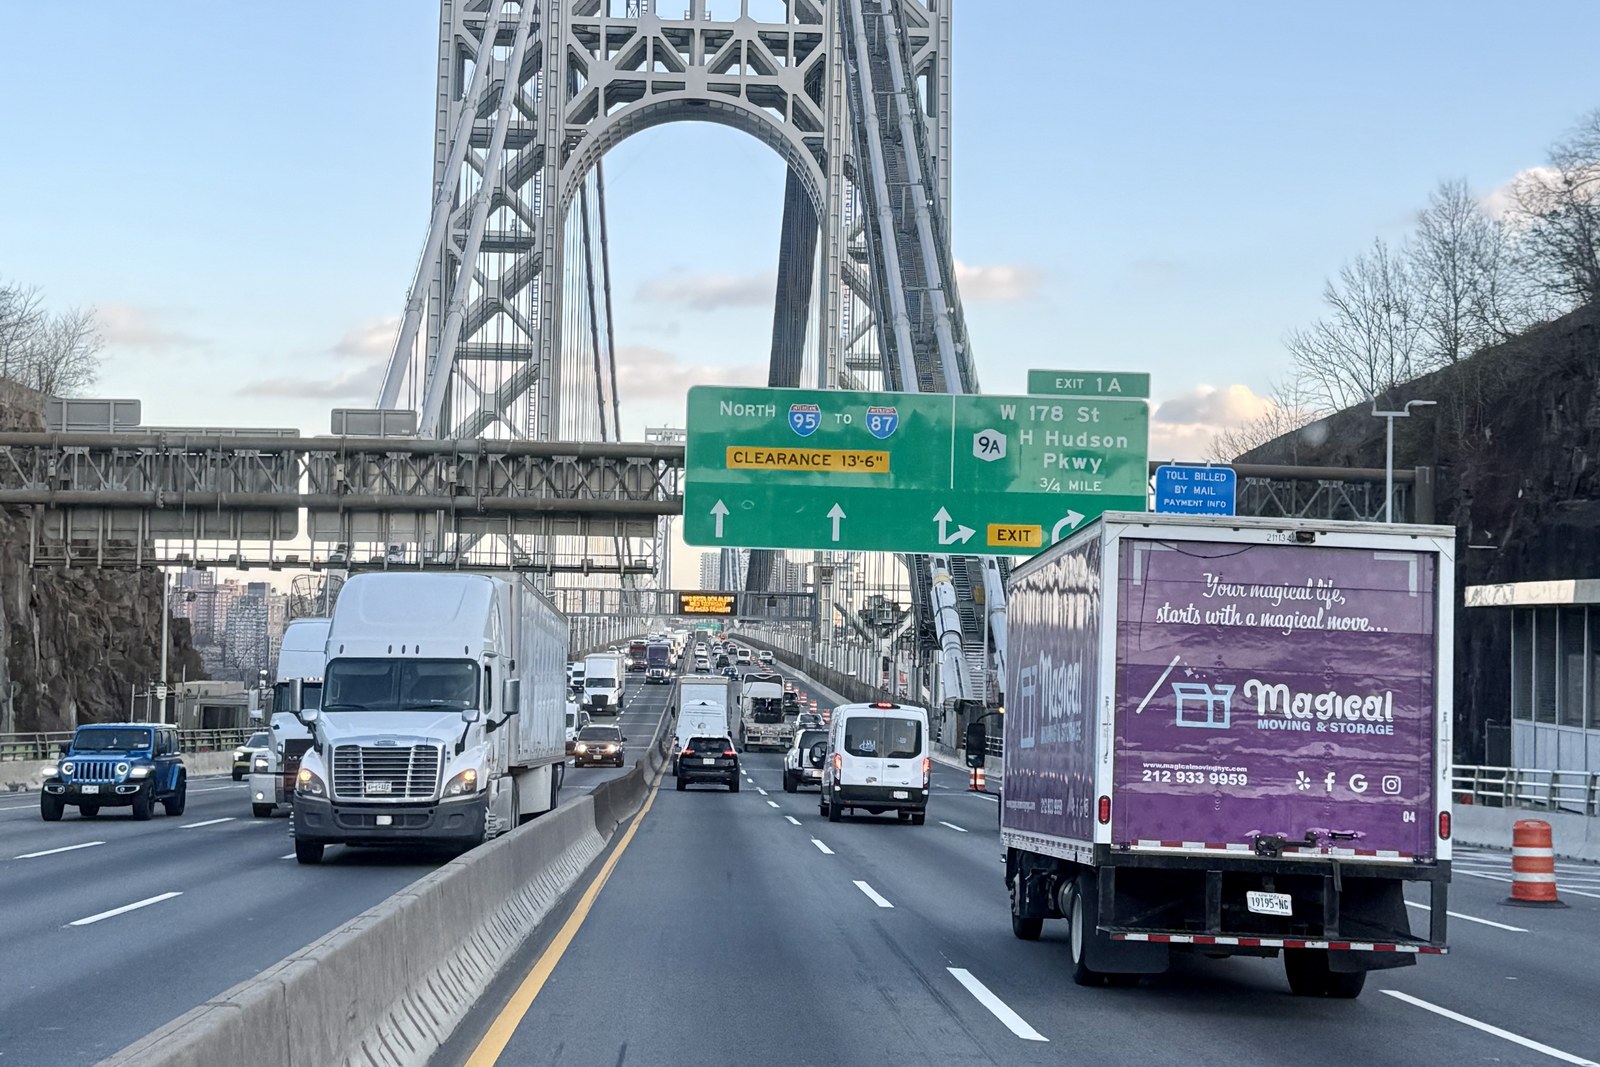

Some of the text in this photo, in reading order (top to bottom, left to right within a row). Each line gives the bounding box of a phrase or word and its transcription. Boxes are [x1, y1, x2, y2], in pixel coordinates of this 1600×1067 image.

[1055, 378, 1084, 389] EXIT
[720, 401, 893, 432] NORTH 95 TO 87
[1001, 405, 1100, 422] W 178 St
[978, 436, 1000, 454] 9A
[1020, 430, 1128, 448] H Hudson
[733, 451, 883, 468] CLEARANCE 13'-6"
[1044, 453, 1102, 474] Pkwy
[1166, 470, 1226, 482] TOLL BILLED
[1069, 480, 1102, 491] MILE
[1174, 485, 1216, 495] BY MAIL
[1163, 498, 1226, 508] PAYMENT INFO
[997, 529, 1031, 542] EXIT
[1203, 573, 1346, 610] Your magical life,
[1156, 602, 1389, 636] starts with a magical move...
[1243, 679, 1394, 722] Magical
[1257, 719, 1394, 736] MOVING & STORAGE
[1142, 762, 1248, 773] www.magicalmovingnyc.com
[1142, 769, 1248, 786] 212 933 9959
[1402, 811, 1416, 823] 04
